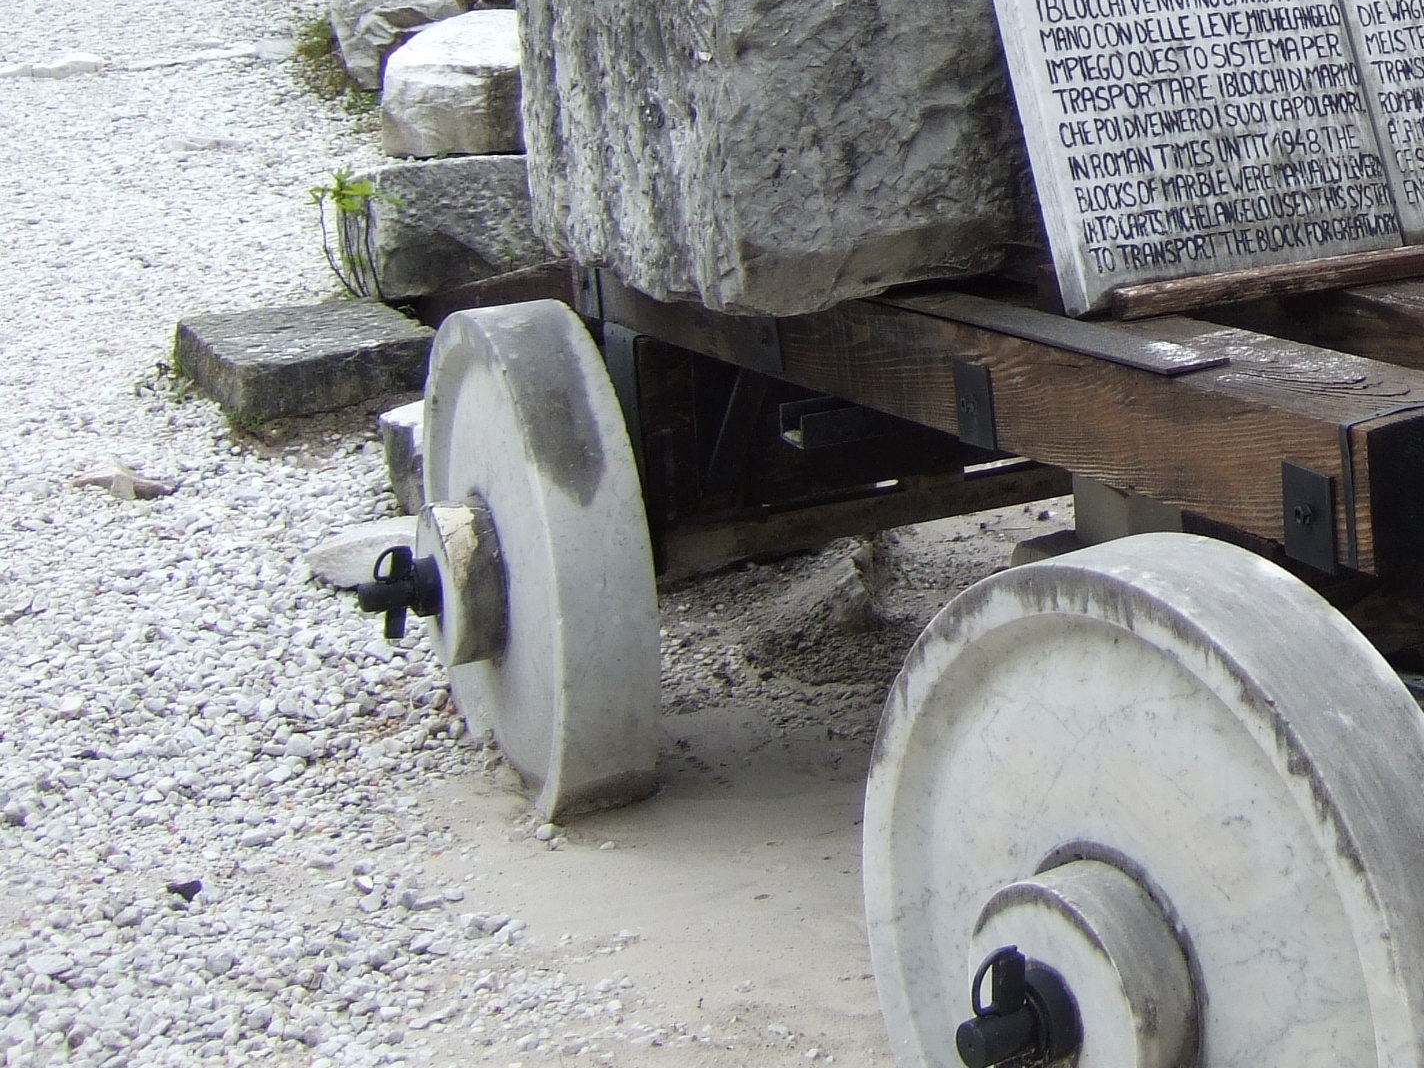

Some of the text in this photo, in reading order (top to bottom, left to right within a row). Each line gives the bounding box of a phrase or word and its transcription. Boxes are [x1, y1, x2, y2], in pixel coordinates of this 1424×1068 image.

[1040, 25, 1091, 52] MANO
[1094, 22, 1133, 49] CON
[1134, 16, 1195, 44] DELLE
[1357, 1, 1386, 27] DIE
[1128, 45, 1208, 78] QUESTO
[1211, 37, 1300, 68] SISTEMA
[1300, 34, 1342, 60] PER
[1224, 68, 1288, 98] BLOCCHI
[1288, 68, 1306, 91] DI
[1306, 62, 1360, 89] MARMO
[1059, 120, 1094, 148] CHE
[1094, 116, 1123, 144] POI
[1123, 107, 1213, 140] DIVENNERO
[1224, 101, 1267, 127] SUOI
[1068, 155, 1090, 180] IN
[1090, 146, 1154, 179] ROMAN
[1152, 140, 1214, 170] TIMES
[1320, 124, 1360, 153] THE
[1395, 149, 1415, 173] CE
[1075, 182, 1136, 213] BLOCKS
[1138, 179, 1159, 205] OF
[1162, 170, 1228, 202] MARBLE
[1228, 164, 1275, 192] WERE
[1271, 190, 1315, 218] USED
[1311, 185, 1347, 213] THIS
[1089, 247, 1116, 273] TO
[1117, 233, 1216, 270] TRANSPORT
[1221, 228, 1256, 255] THE
[1257, 222, 1305, 252] BLOCK
[1304, 219, 1334, 247] FOR
